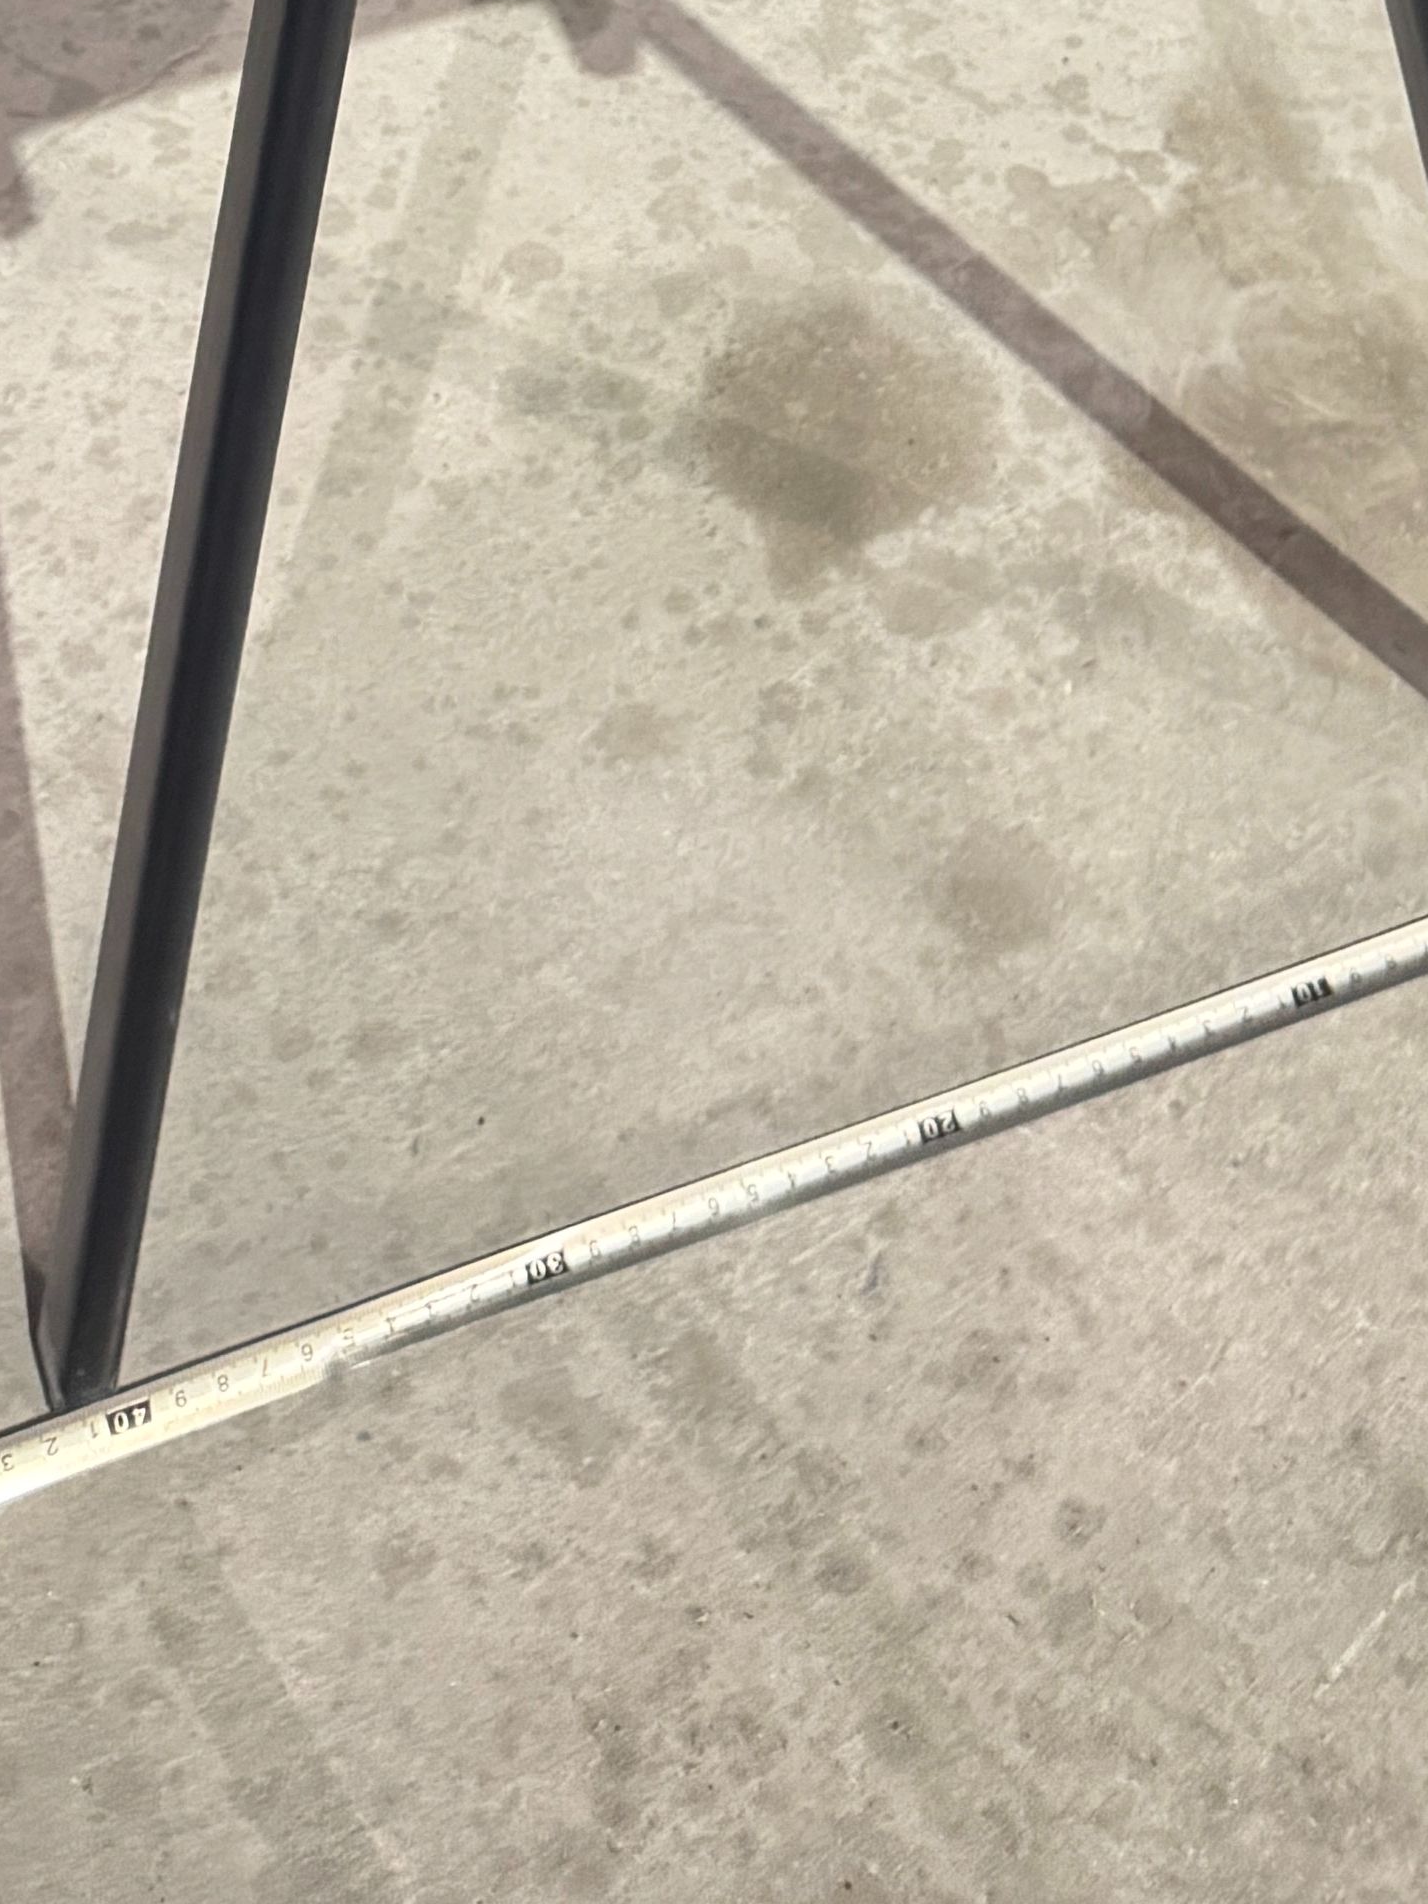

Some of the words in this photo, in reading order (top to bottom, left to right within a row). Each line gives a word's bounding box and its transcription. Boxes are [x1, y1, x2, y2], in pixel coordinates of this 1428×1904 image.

[920, 1109, 960, 1140] 20
[746, 1183, 760, 1203] 5
[708, 1196, 721, 1217] 6
[527, 1252, 566, 1282] 30
[300, 1342, 314, 1363] 6
[216, 1374, 230, 1393] 8
[175, 1389, 188, 1408] 9
[111, 1405, 149, 1436] 40
[40, 1436, 59, 1457] 2
[0, 1453, 15, 1472] 3
